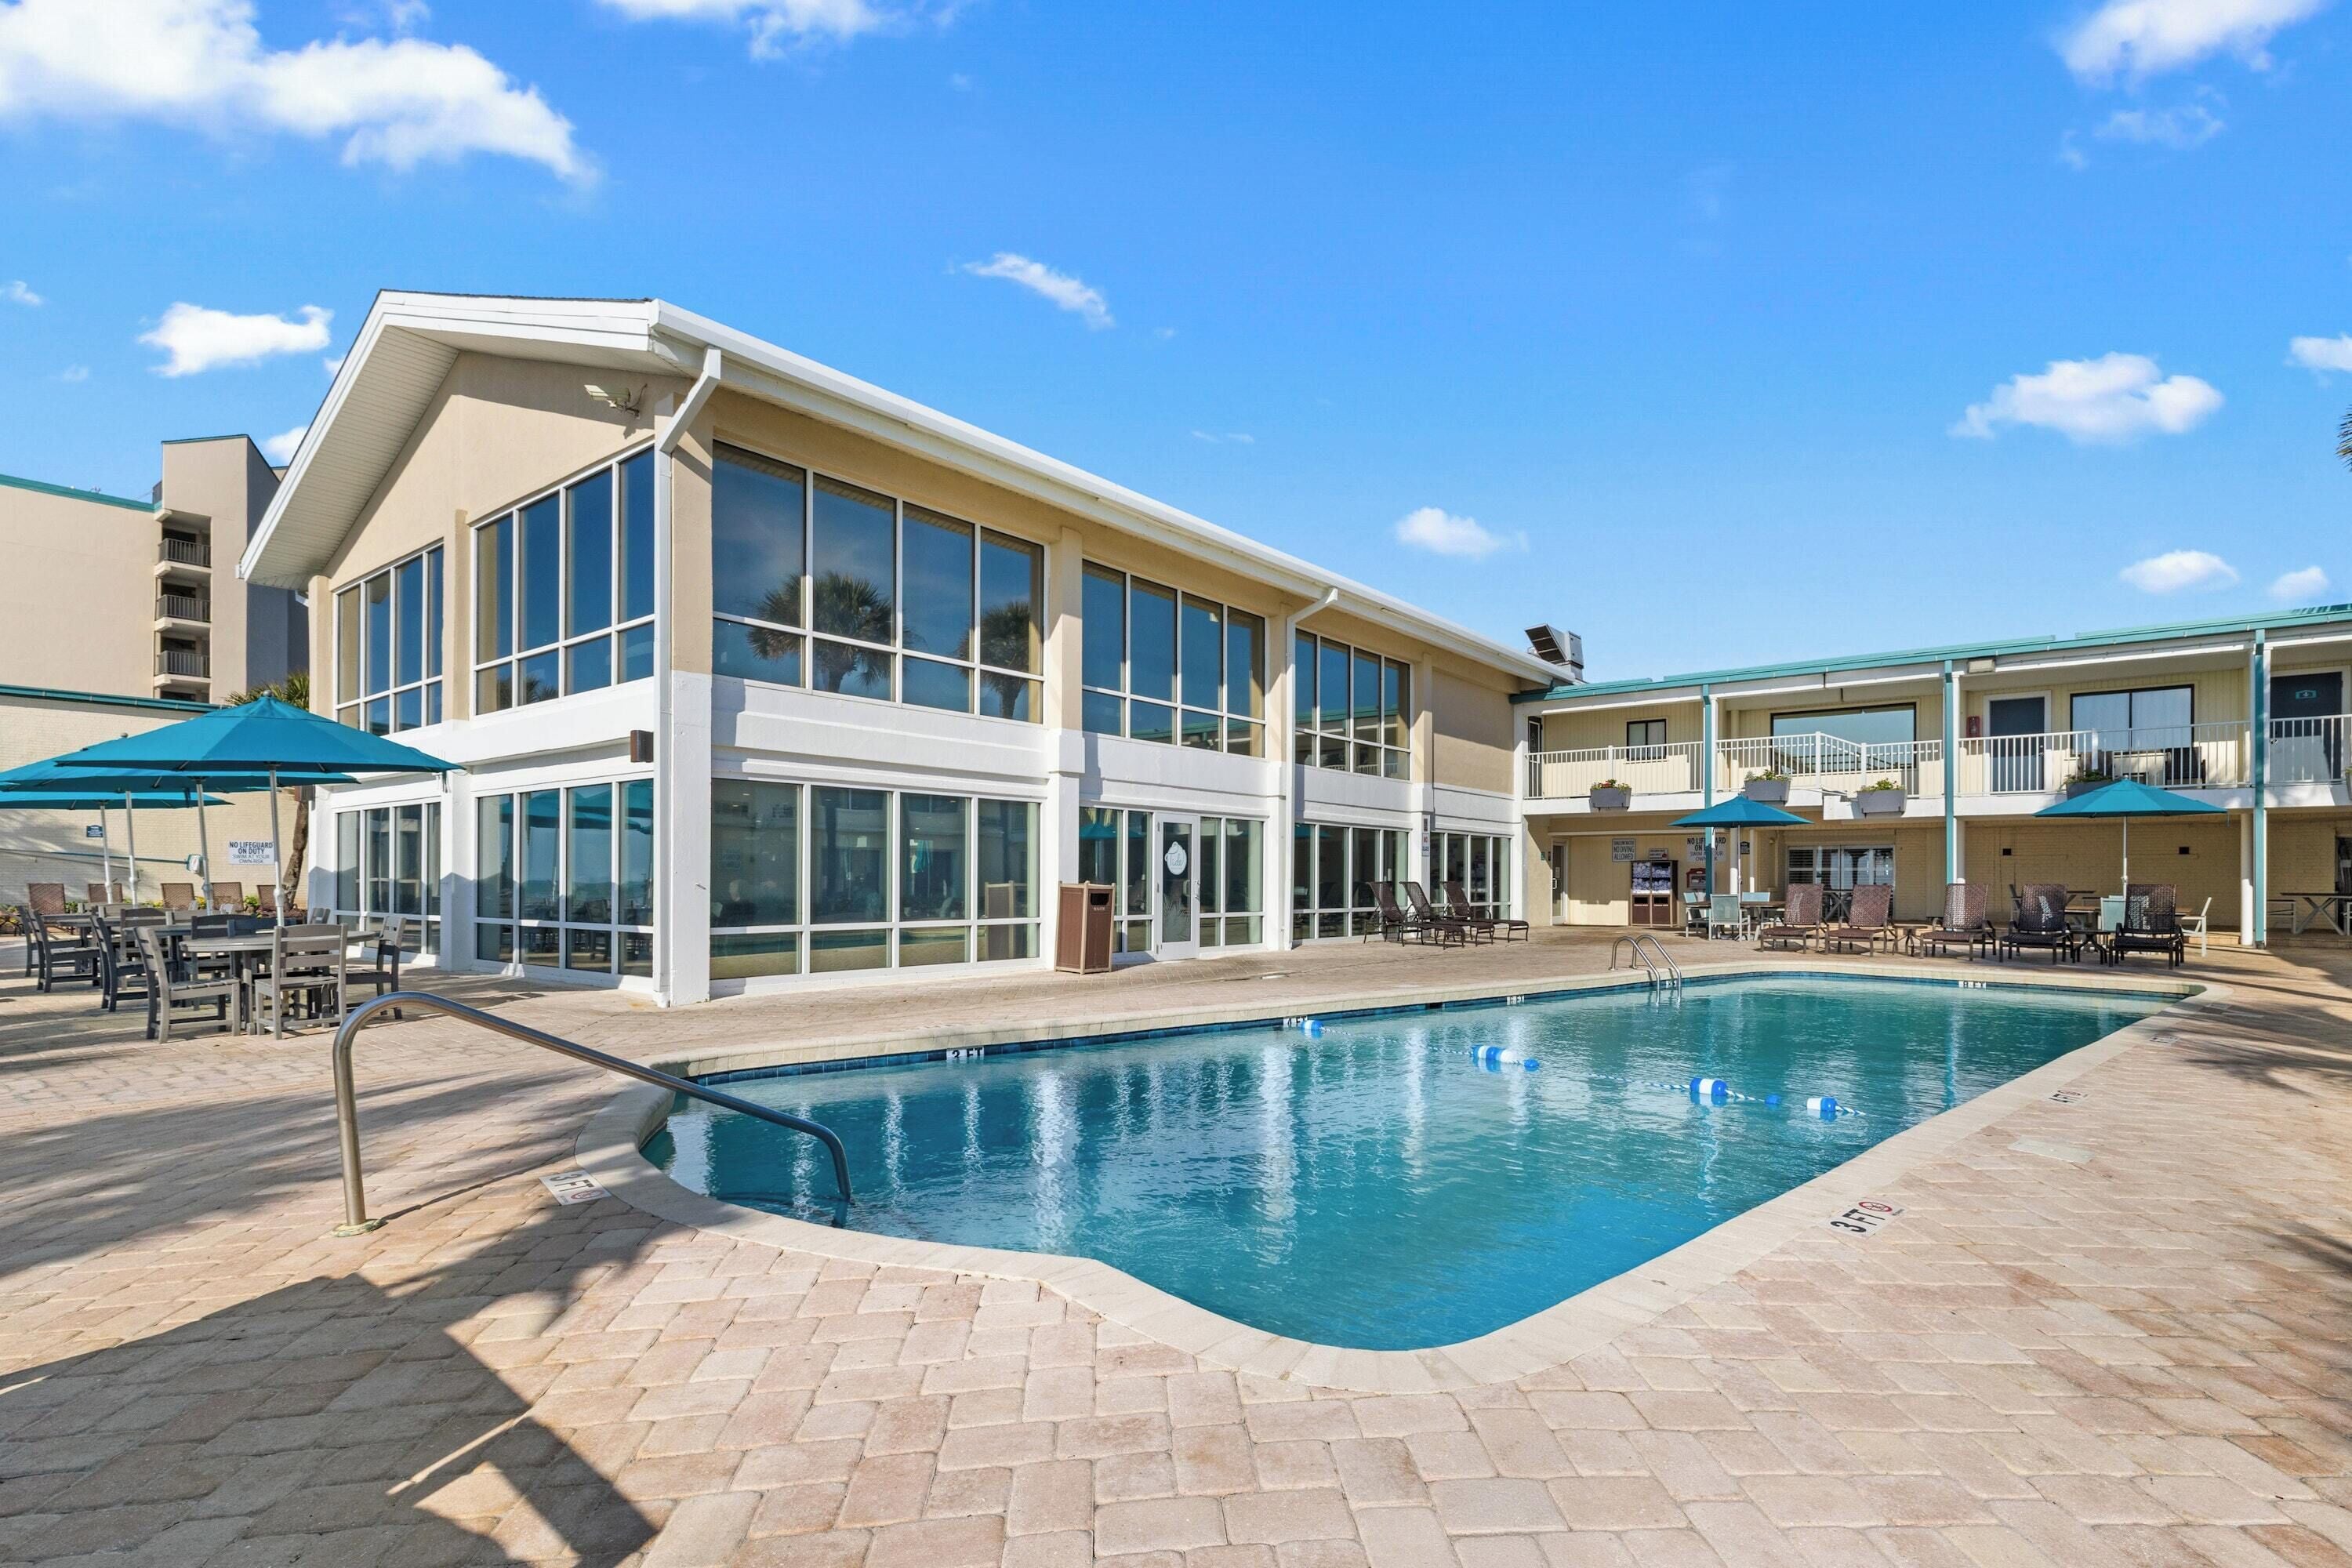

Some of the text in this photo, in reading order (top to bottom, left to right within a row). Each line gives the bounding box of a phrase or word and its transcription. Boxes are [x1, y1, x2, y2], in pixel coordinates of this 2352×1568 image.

[554, 1179, 594, 1192] FT
[1842, 1208, 1886, 1226] FT
[1830, 1221, 1867, 1232] 3
